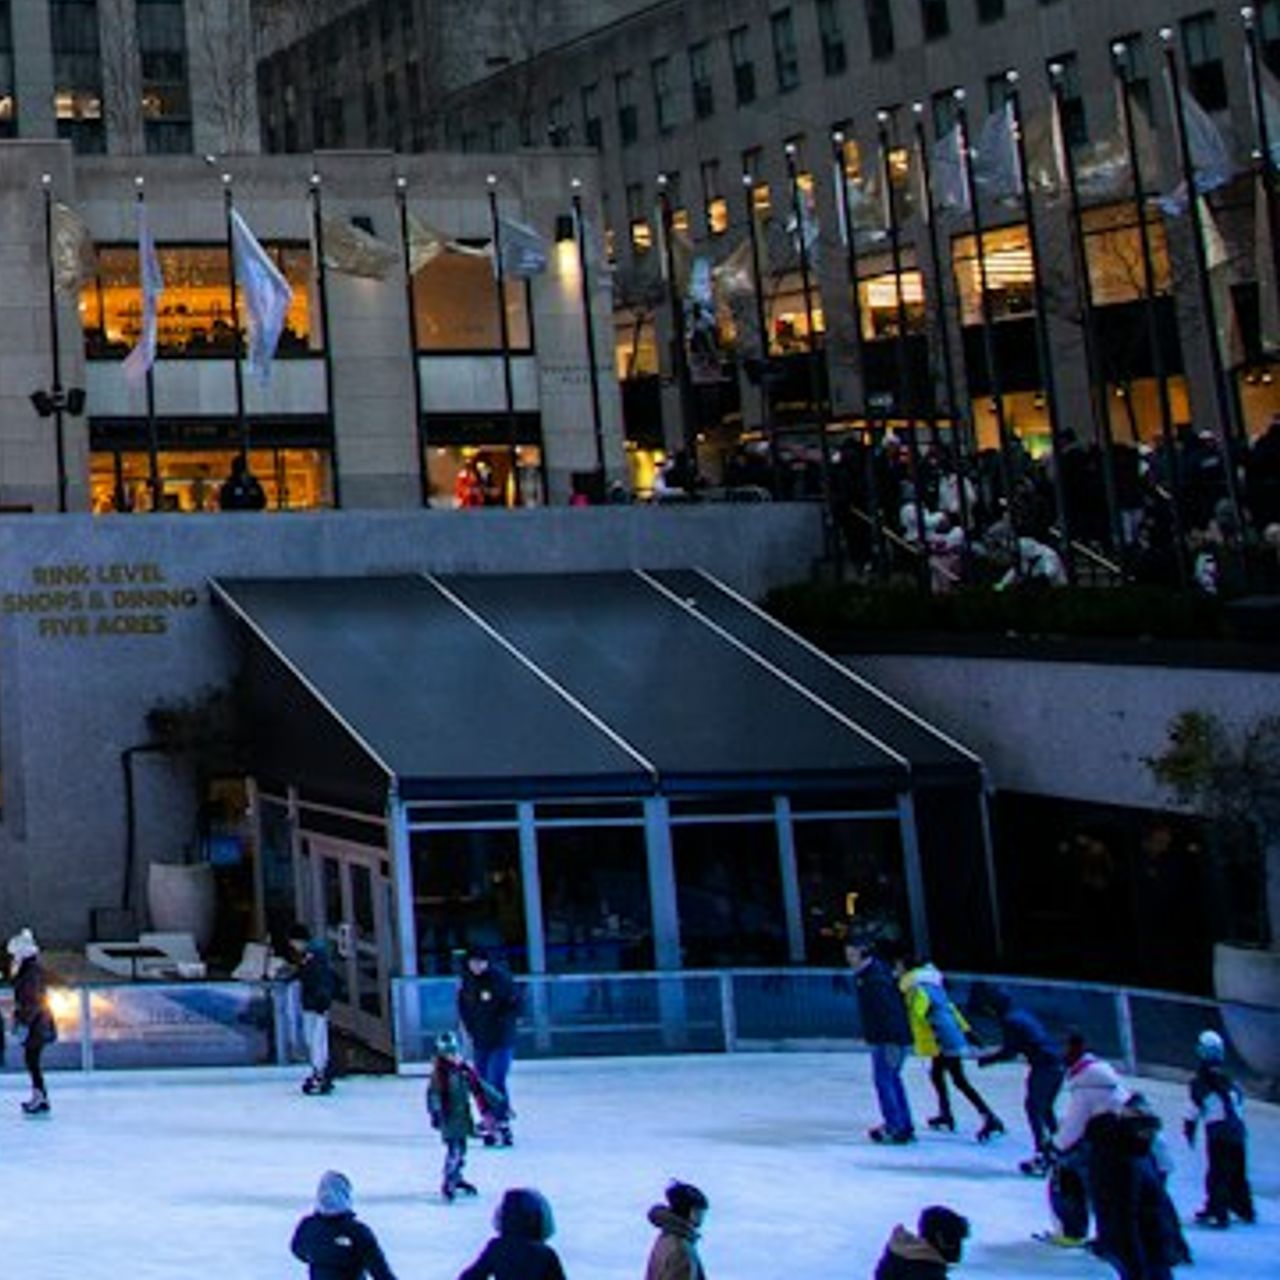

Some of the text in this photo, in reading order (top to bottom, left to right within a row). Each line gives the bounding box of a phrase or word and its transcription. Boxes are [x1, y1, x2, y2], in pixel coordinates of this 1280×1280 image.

[32, 563, 167, 585] RINK LEVEL
[2, 591, 83, 613] SHOPS
[113, 588, 198, 608] DINING
[39, 617, 88, 637] FIVE
